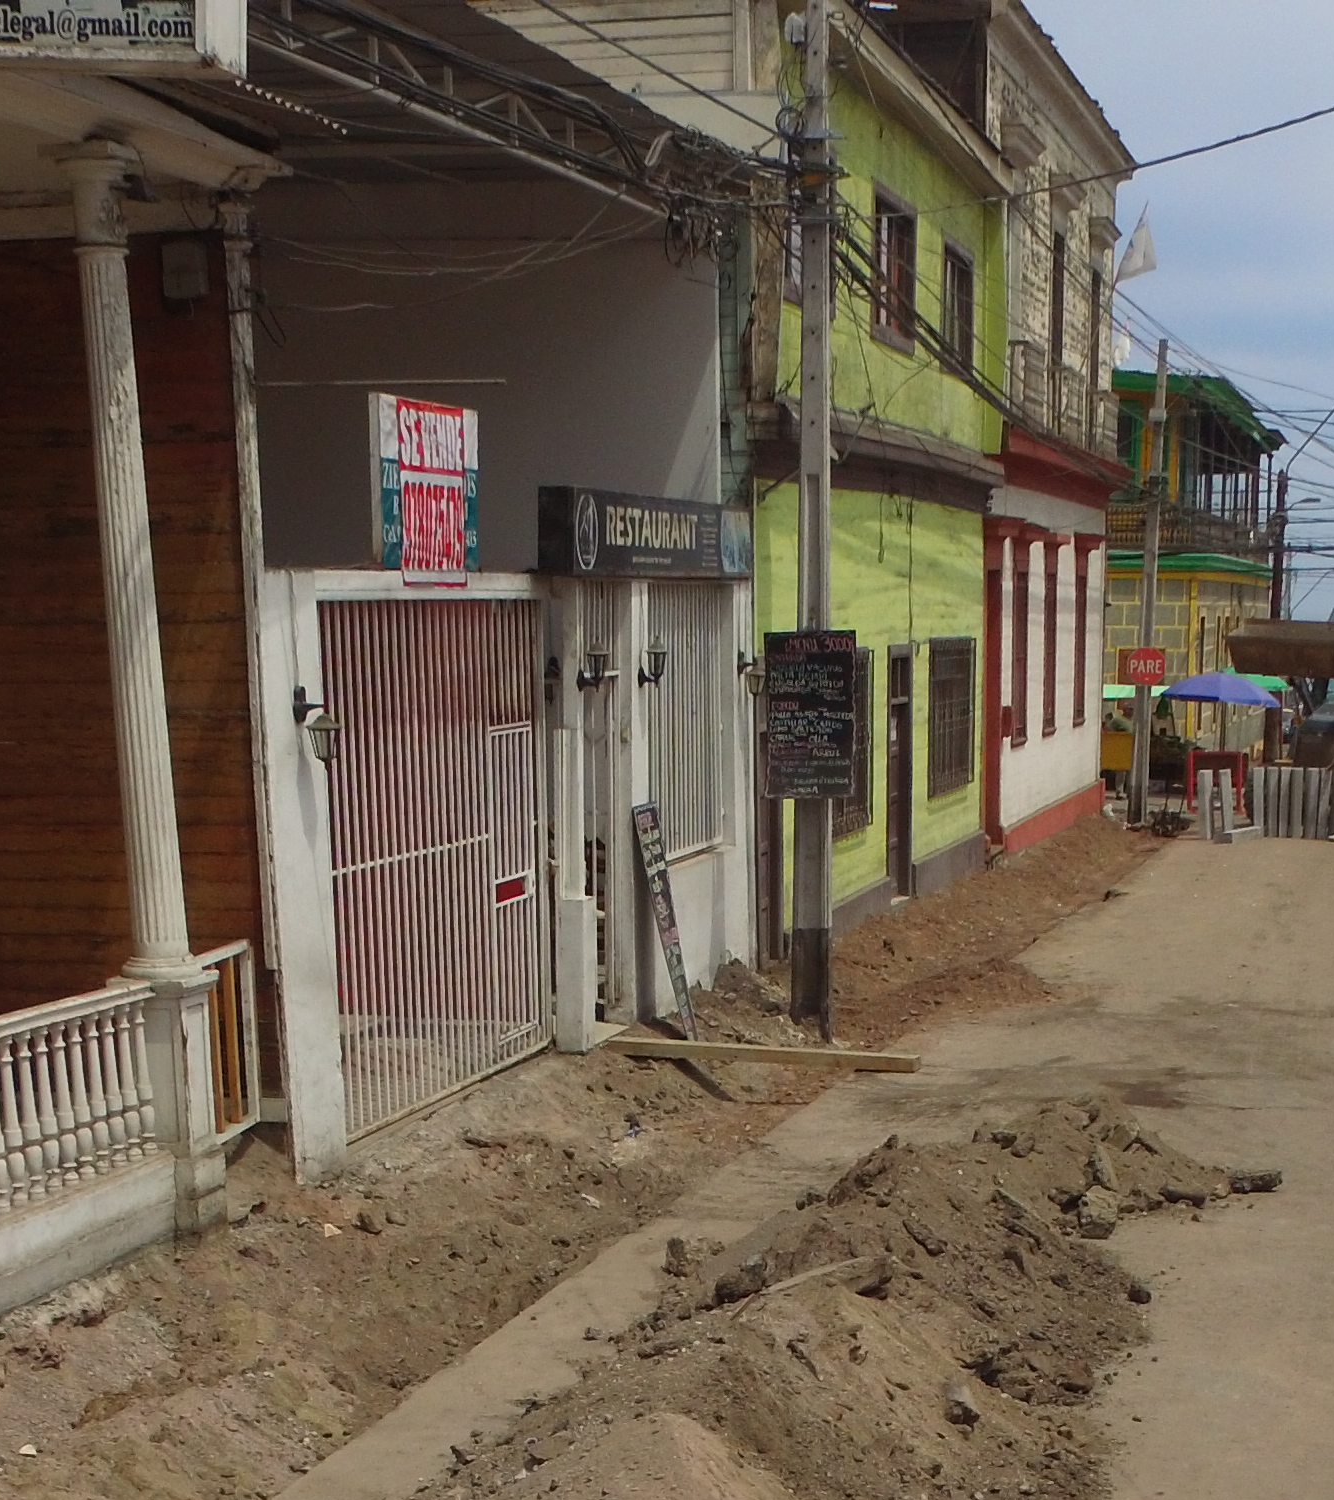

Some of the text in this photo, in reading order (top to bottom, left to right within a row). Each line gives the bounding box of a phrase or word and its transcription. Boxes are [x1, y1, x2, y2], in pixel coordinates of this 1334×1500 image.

[399, 405, 464, 471] SE VENDE
[605, 505, 698, 549] RESTAURANT
[1130, 659, 1163, 674] PARE
